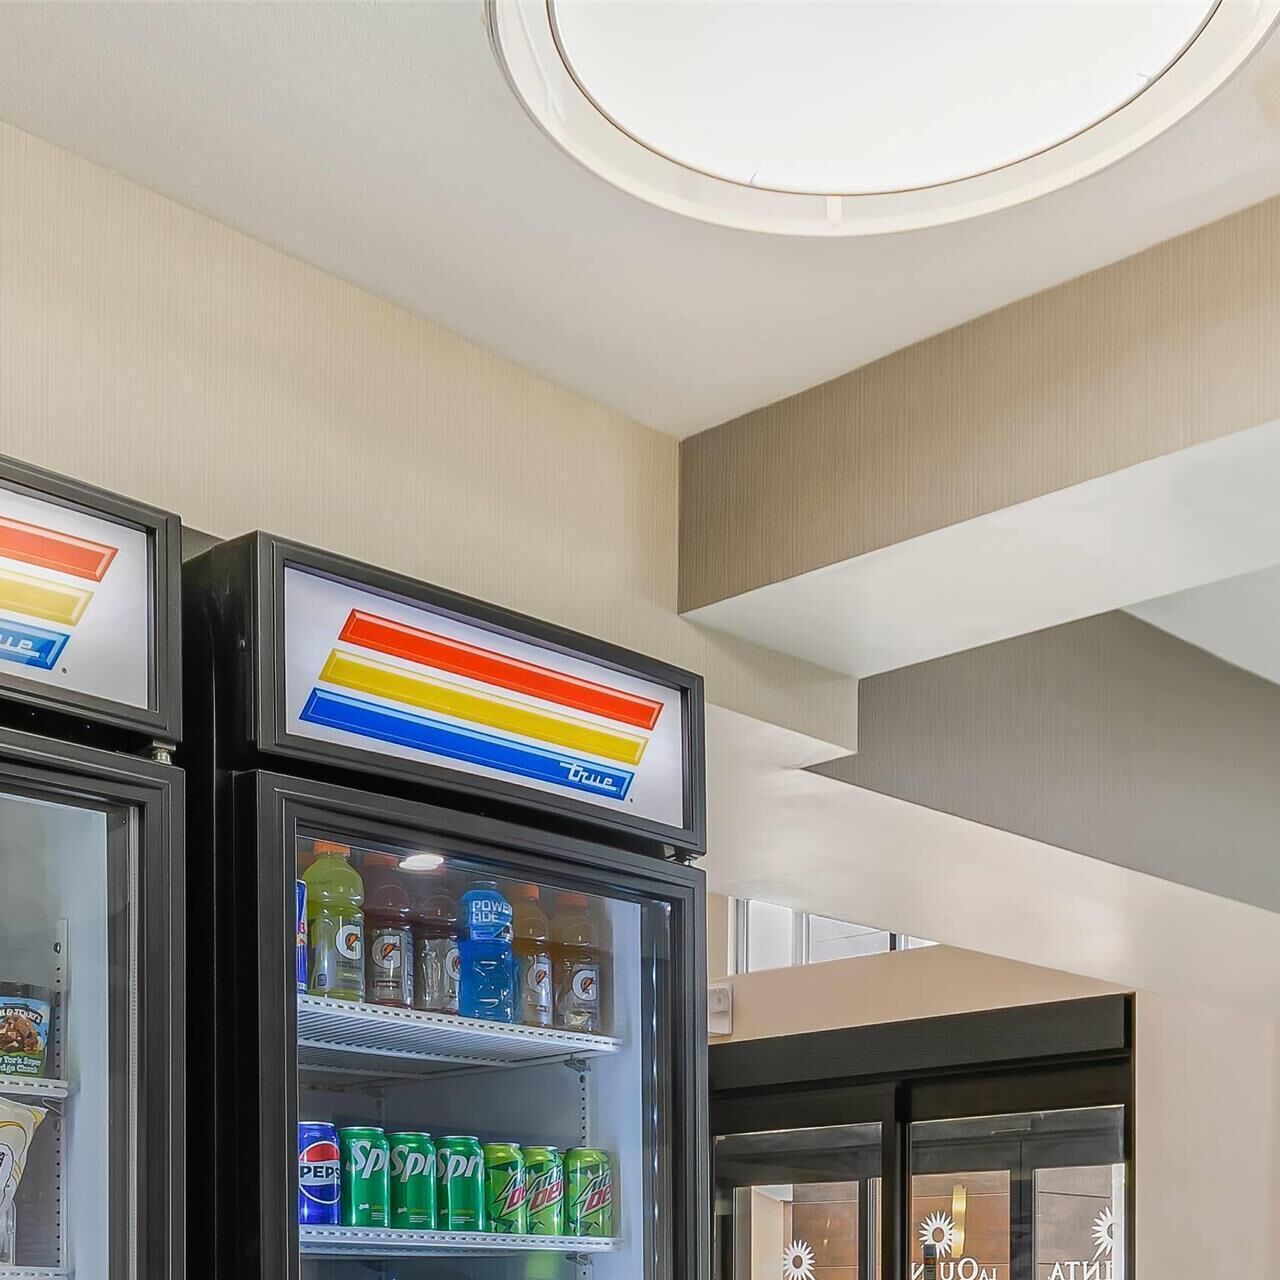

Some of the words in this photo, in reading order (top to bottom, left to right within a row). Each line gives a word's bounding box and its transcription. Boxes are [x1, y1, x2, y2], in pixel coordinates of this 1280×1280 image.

[560, 762, 617, 792] true
[372, 936, 401, 969] G
[572, 970, 597, 1001] G
[4, 1055, 22, 1065] York
